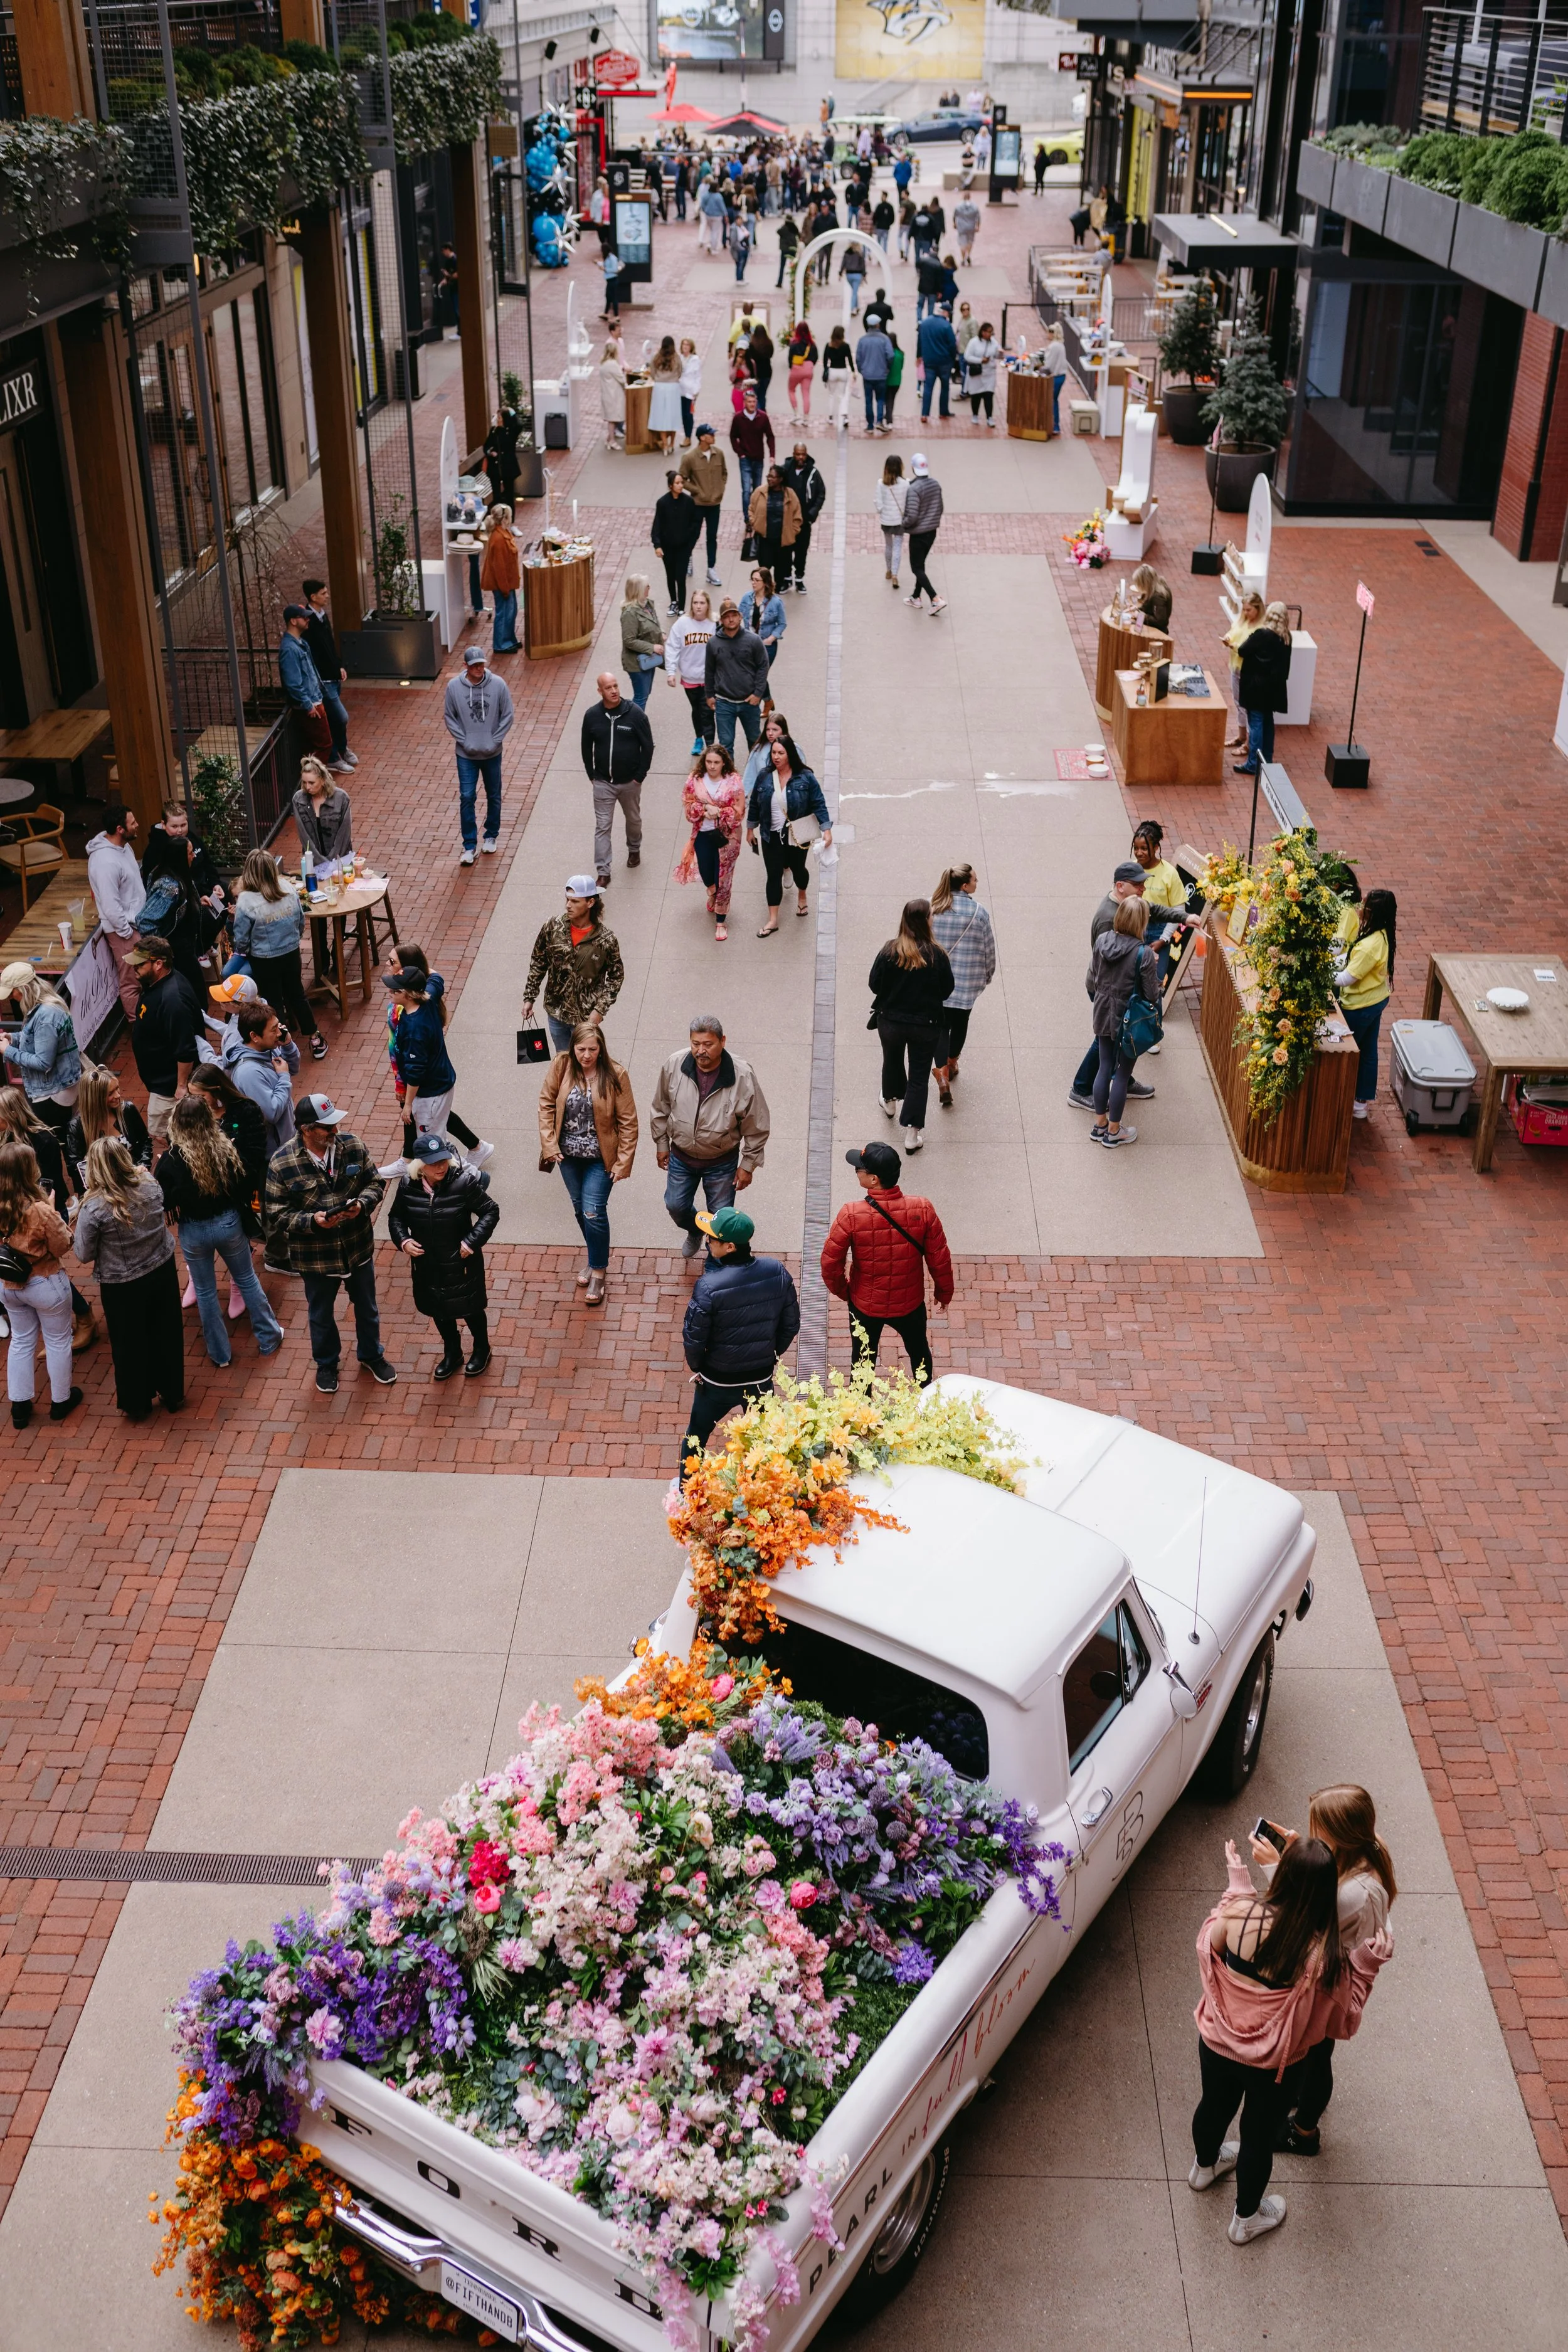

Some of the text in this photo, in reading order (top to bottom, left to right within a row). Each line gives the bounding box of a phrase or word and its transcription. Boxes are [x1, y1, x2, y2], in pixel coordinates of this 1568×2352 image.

[684, 632, 713, 646] MIZZO
[80, 979, 92, 1021] the
[139, 1004, 147, 1019] T
[809, 1959, 1036, 2296] PEARL IN full bloom
[464, 2277, 497, 2302] TENNESSEE
[463, 2302, 495, 2327] ANTIQUE AUTO
